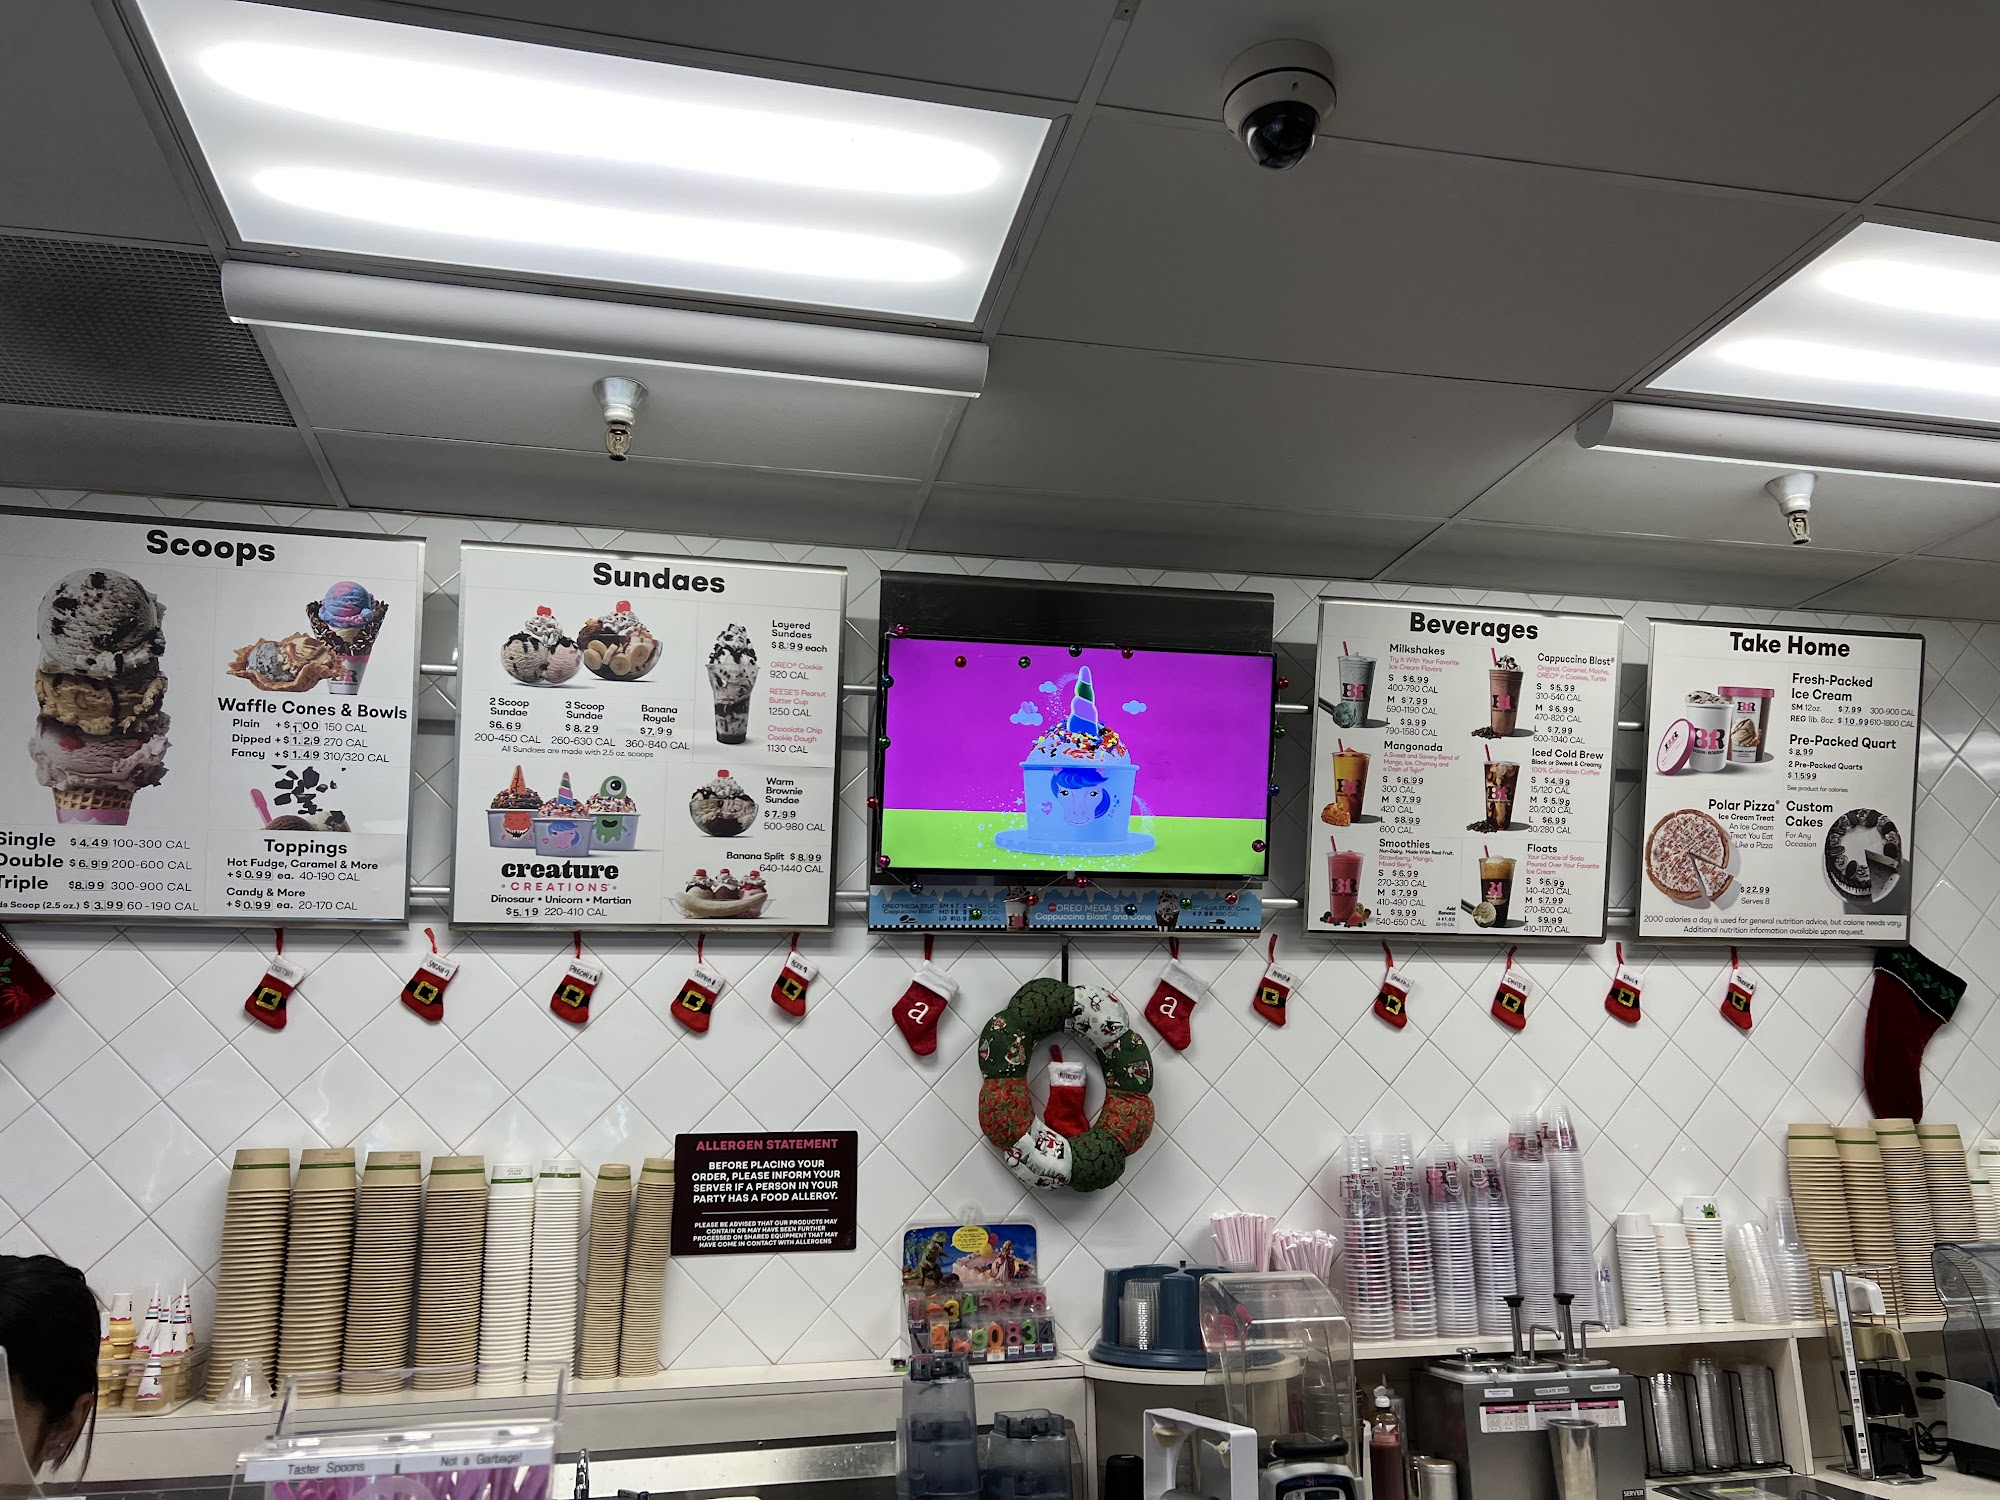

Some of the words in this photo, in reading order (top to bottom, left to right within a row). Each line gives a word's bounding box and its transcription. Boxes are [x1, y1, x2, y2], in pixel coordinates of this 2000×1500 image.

[146, 528, 275, 566] Scoops
[593, 562, 725, 592] Sundaes
[773, 620, 810, 630] Layered
[1410, 612, 1538, 643] Beverages
[772, 629, 812, 638] Sundaes
[1390, 644, 1445, 655] Milkshakes
[1730, 632, 1780, 654] Take
[1787, 636, 1850, 657] Home
[1538, 653, 1587, 664] Cappuccino
[1793, 673, 1873, 687] Fresh-Packed
[1792, 688, 1809, 699] Ice
[1813, 689, 1851, 701] Cream
[218, 697, 277, 713] Waffle
[282, 701, 336, 716] Cones
[341, 704, 351, 717] &
[358, 704, 407, 719] Bowls
[499, 699, 529, 708] Scoop
[566, 701, 572, 709] 3
[575, 702, 604, 711] Scoop
[642, 705, 677, 713] Banana
[490, 707, 528, 716] Sundae
[567, 711, 603, 720] Sundae
[1870, 707, 1899, 715] 300-900
[643, 714, 675, 724] Royale
[232, 719, 260, 728] Plain
[324, 723, 342, 731] 150
[345, 724, 367, 732] CAL
[232, 734, 271, 745] Dipped
[324, 739, 342, 747] 270
[346, 739, 368, 747] CAL
[474, 733, 517, 742] 200-450
[520, 735, 541, 743] CAL
[551, 736, 592, 745] 260-630
[595, 737, 615, 746] CAL
[1790, 734, 1858, 747] Pre-Packed
[1862, 737, 1896, 749] Quart
[626, 740, 667, 749] 360-840
[670, 741, 690, 750] CAL
[1384, 741, 1442, 752] Mangonada
[232, 749, 265, 759] Fancy
[323, 753, 365, 761] 310/320
[368, 754, 389, 762] CAL
[1532, 748, 1552, 756] Iced
[1555, 749, 1576, 758] Cold
[1580, 751, 1603, 759] Brew
[1580, 761, 1601, 769] Creamy
[766, 787, 802, 795] Brownie
[766, 796, 799, 804] Sundae
[1709, 799, 1740, 810] Polar
[1786, 801, 1833, 812] Custom
[764, 822, 803, 830] 500-980
[807, 823, 825, 831] CAL
[1786, 816, 1823, 827] Cakes
[0, 832, 55, 850] Single
[113, 839, 162, 848] 100-300
[166, 841, 190, 849] CAL
[1798, 832, 1811, 840] Any
[264, 839, 347, 857] Toppings
[1379, 839, 1430, 848] Smoothies
[1528, 844, 1557, 853] Floats
[0, 853, 63, 868] Double
[112, 860, 164, 869] 200-600
[168, 861, 192, 870] CAL
[764, 852, 785, 861] Split
[228, 858, 248, 867] Hot
[251, 859, 287, 869] Fudge,
[291, 860, 337, 868] Caramel
[351, 861, 378, 869] More
[760, 864, 802, 872] 640-1440
[502, 861, 618, 879] creature
[300, 872, 334, 880] 40-190
[338, 873, 360, 881] CAL
[0, 875, 48, 892] Triple
[111, 882, 163, 890] 300-900
[167, 883, 191, 891] CAL
[227, 888, 263, 898] Candy
[278, 889, 305, 897] More
[298, 901, 332, 910] 20-170
[336, 902, 357, 910] CAL
[546, 896, 582, 904] Unicorn
[594, 896, 631, 904] Martian
[11, 902, 40, 910] Scoop
[175, 902, 199, 911] CAL
[545, 908, 584, 916] 220-410
[587, 908, 607, 916] CAL
[1035, 912, 1085, 922] Cappuccino
[908, 1001, 929, 1024] a
[1159, 996, 1178, 1019] a
[696, 1141, 763, 1151] ALLERGEN
[766, 1139, 839, 1150] STATEMENT
[709, 1161, 748, 1170] BEFORE
[751, 1160, 796, 1169] PLACING
[797, 1160, 825, 1168] YOUR
[692, 1172, 730, 1182] ORDER,
[732, 1171, 769, 1180] PLEASE
[772, 1171, 811, 1179] INFORM
[813, 1170, 840, 1178] YOUR
[693, 1183, 732, 1192] SERVER
[734, 1183, 744, 1191] IF
[746, 1183, 753, 1191] A
[755, 1182, 796, 1191] PERSON
[810, 1181, 838, 1189] YOUR
[693, 1194, 727, 1203] PARTY
[728, 1194, 749, 1202] HAS
[751, 1194, 758, 1202] A
[761, 1193, 789, 1201] FOOD
[791, 1192, 838, 1201] ALLERGY.
[288, 1463, 322, 1476] Taster
[326, 1461, 365, 1475] Spoons
[440, 1454, 459, 1467] Not
